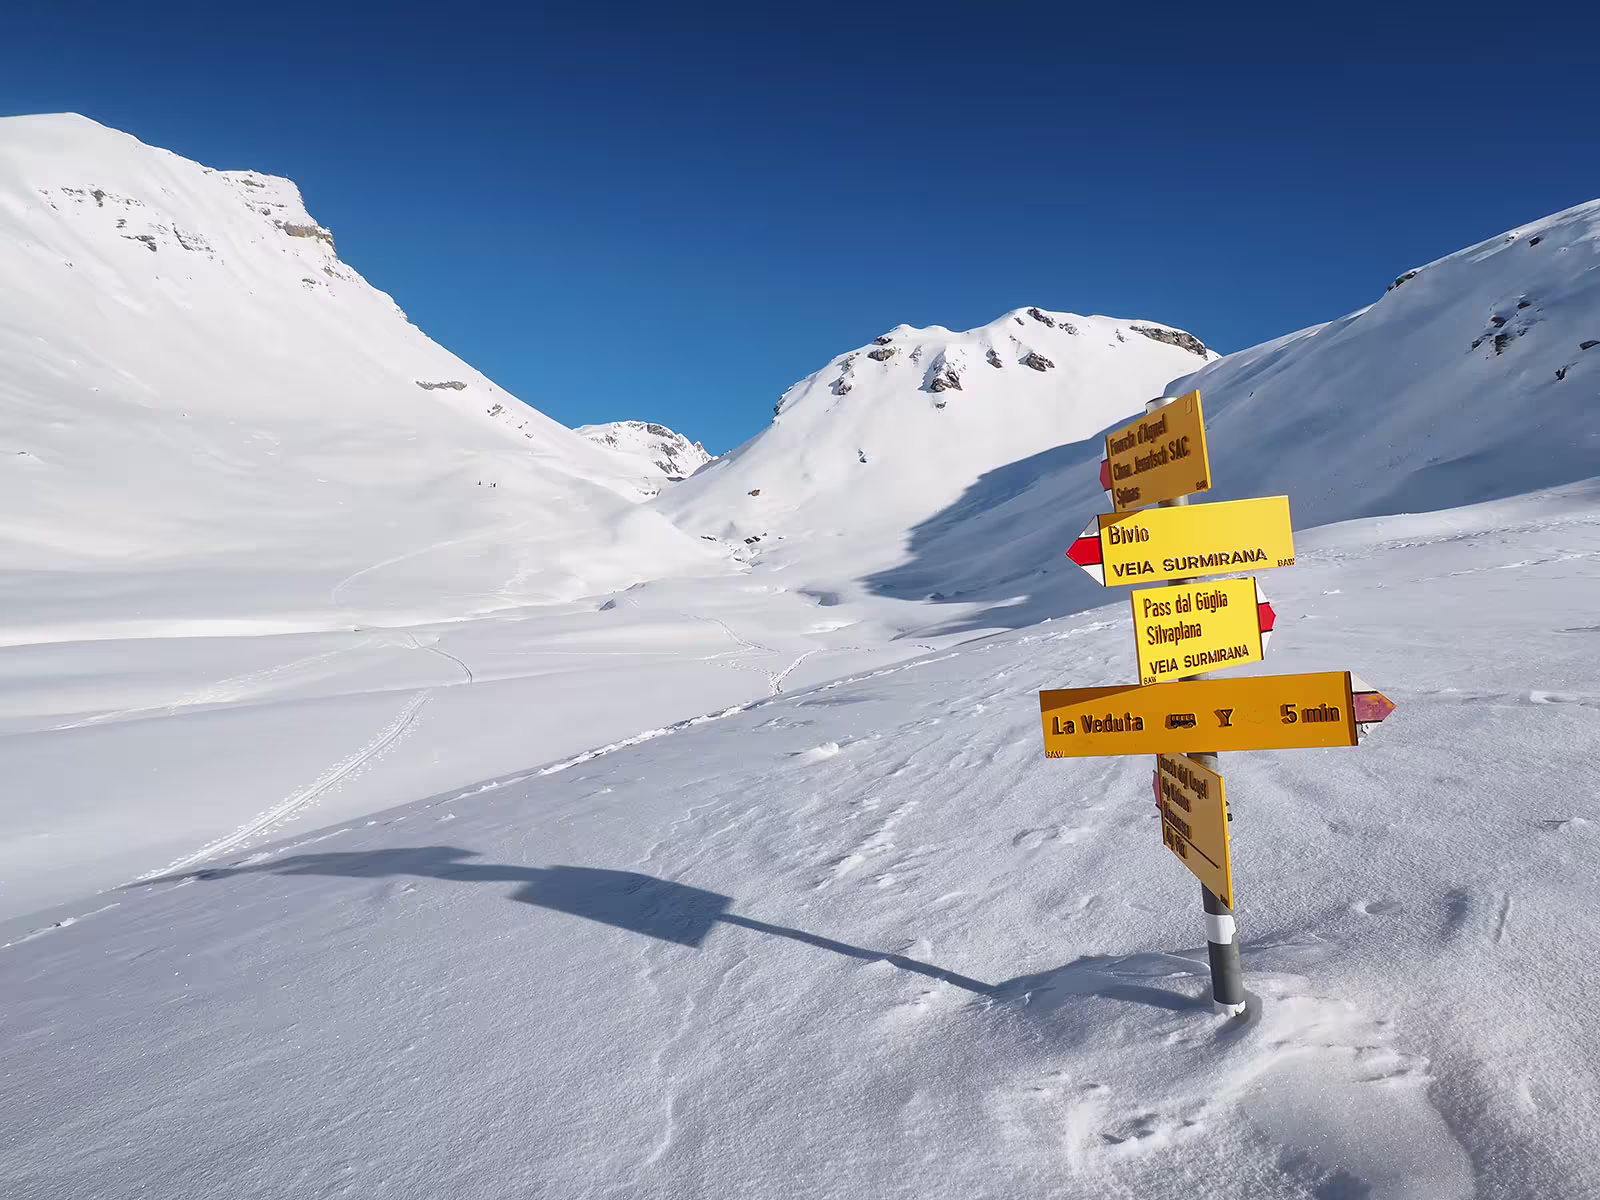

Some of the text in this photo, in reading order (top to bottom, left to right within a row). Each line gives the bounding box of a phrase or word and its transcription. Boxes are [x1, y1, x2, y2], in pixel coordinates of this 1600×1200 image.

[1134, 445, 1168, 475] Jenatsch
[1168, 436, 1190, 461] SAC
[1108, 525, 1150, 545] Bivio
[1112, 548, 1268, 577] VEIA SURMIRANA
[1143, 590, 1228, 618] Pass dal Güglia
[1147, 620, 1202, 646] Silvaplana
[1149, 644, 1249, 675] VEIA SURMIRANA
[1052, 703, 1341, 735] La Veduta 5 min
